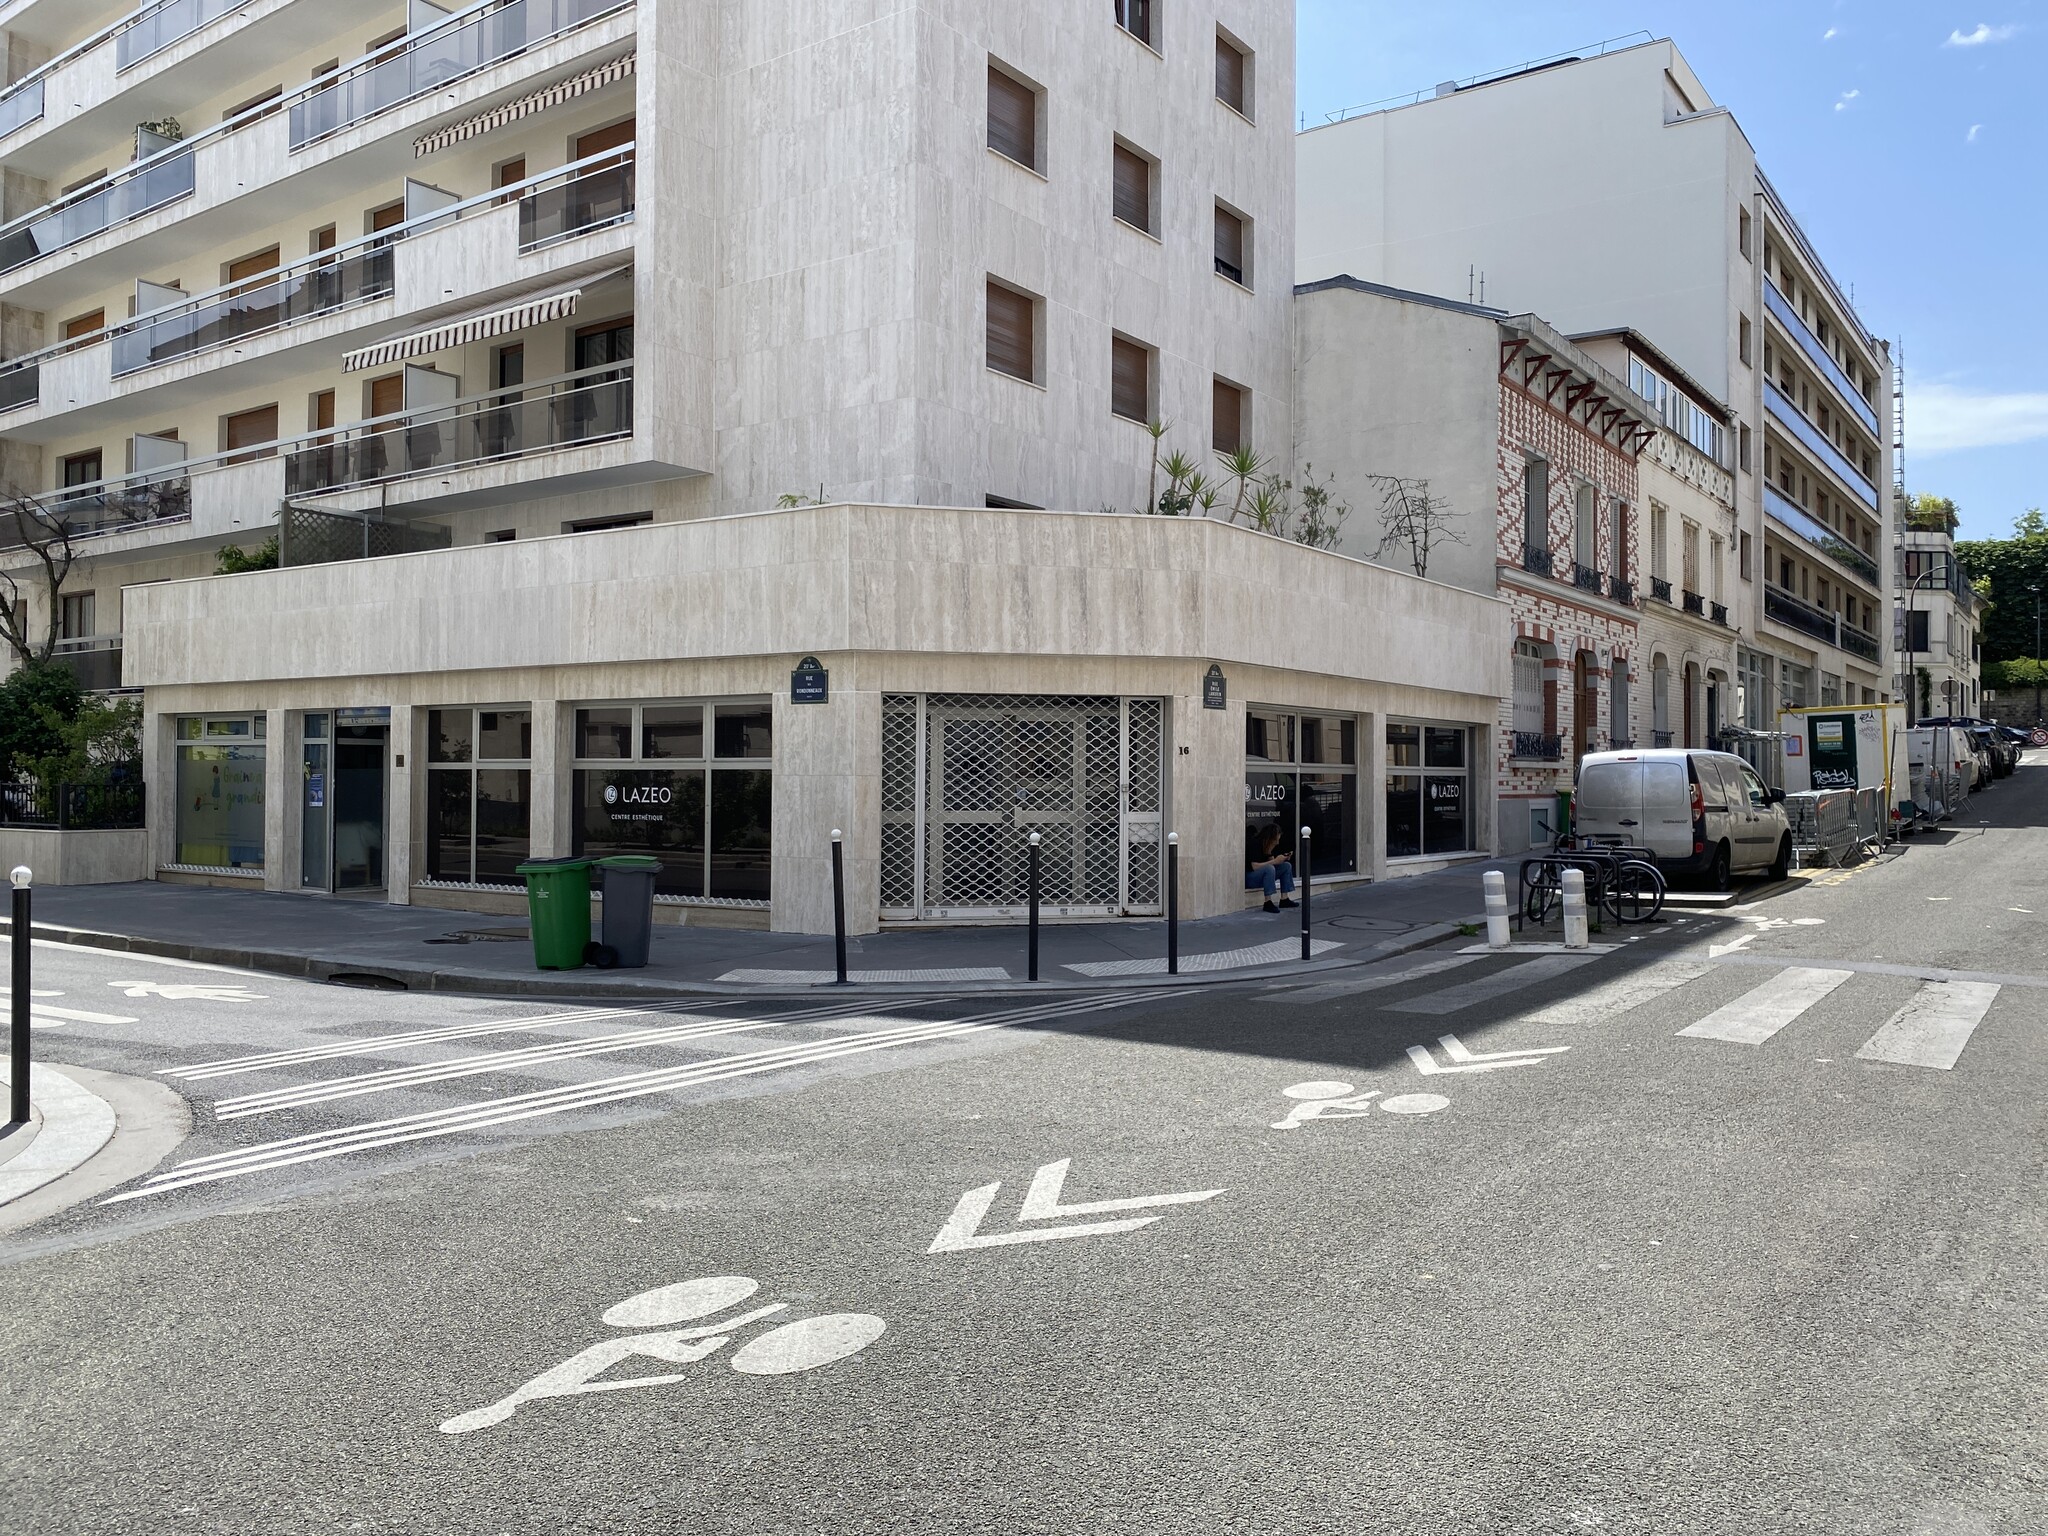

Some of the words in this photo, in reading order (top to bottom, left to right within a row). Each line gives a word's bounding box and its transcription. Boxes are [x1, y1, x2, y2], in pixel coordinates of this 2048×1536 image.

[1179, 746, 1189, 755] 16
[622, 786, 671, 803] LAZEO
[1254, 784, 1285, 800] LAZEO
[1438, 784, 1459, 798] LAZEO
[632, 813, 663, 821] ESTHÉTIQUE
